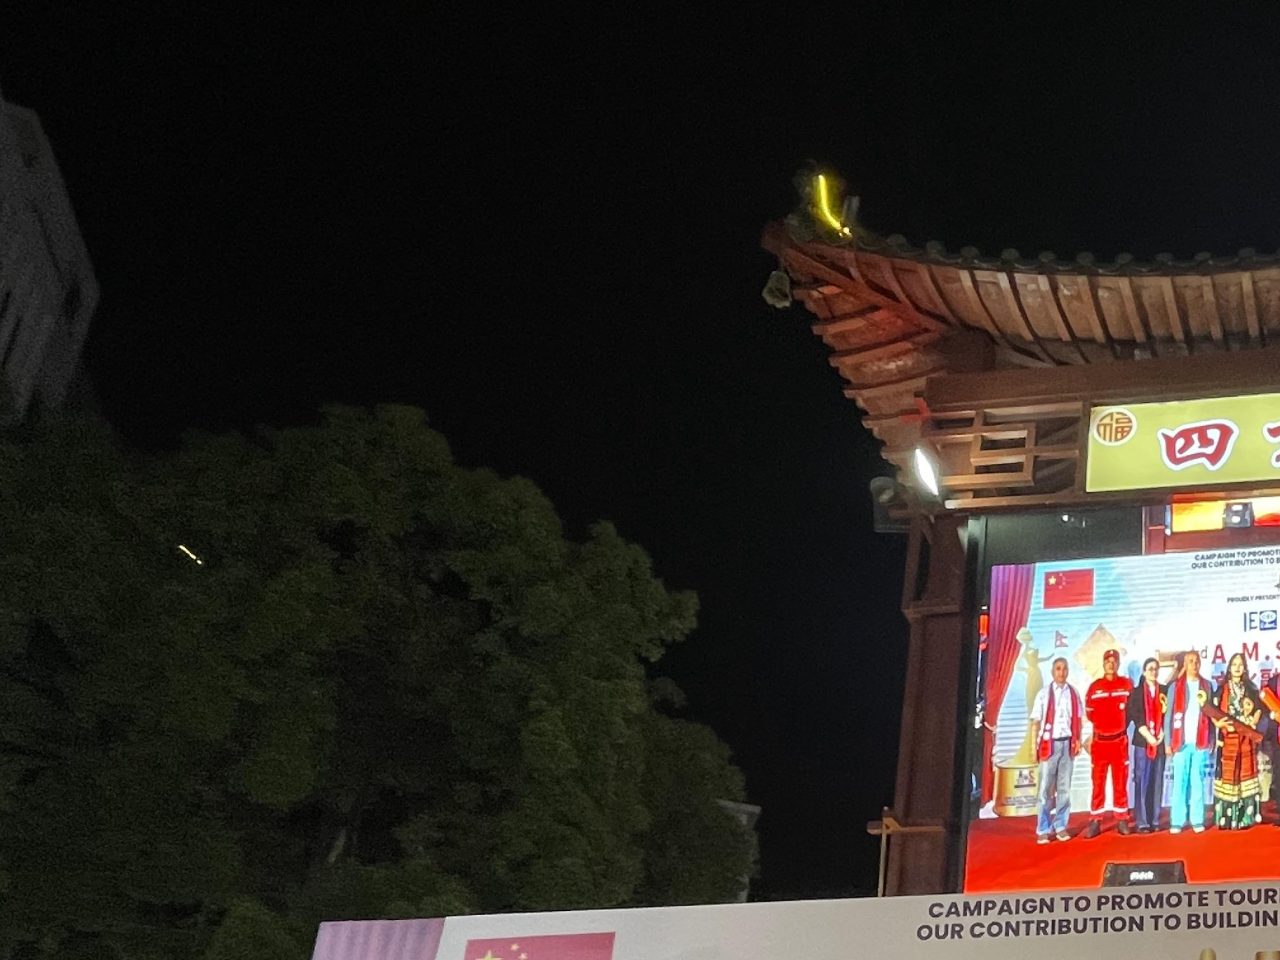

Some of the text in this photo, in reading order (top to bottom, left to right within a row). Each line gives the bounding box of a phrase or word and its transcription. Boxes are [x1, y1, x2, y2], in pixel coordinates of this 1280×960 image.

[929, 897, 1055, 918] CAMPAIGN
[1060, 896, 1091, 913] TO
[1097, 890, 1209, 911] PROMOTE
[916, 922, 963, 941] OUR
[969, 915, 1144, 939] CONTRIBUTION
[1149, 913, 1182, 931] TO
